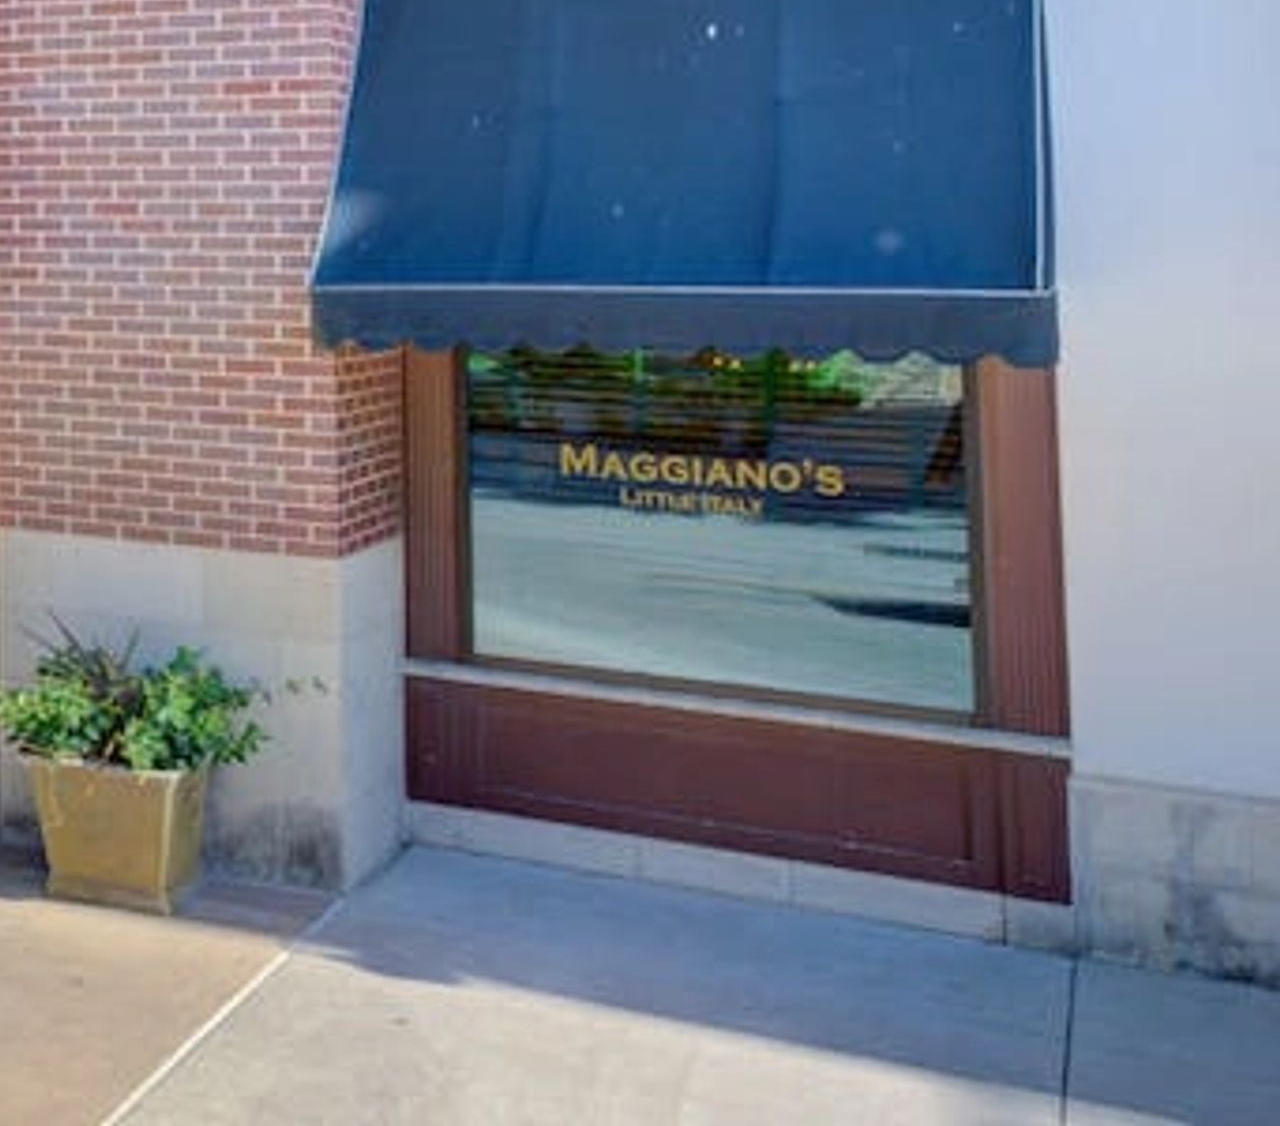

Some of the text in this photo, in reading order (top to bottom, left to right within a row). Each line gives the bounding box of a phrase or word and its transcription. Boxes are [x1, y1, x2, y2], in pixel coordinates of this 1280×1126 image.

[559, 442, 846, 497] MAGGIANO'S
[619, 485, 764, 517] LITTLE ITALY
